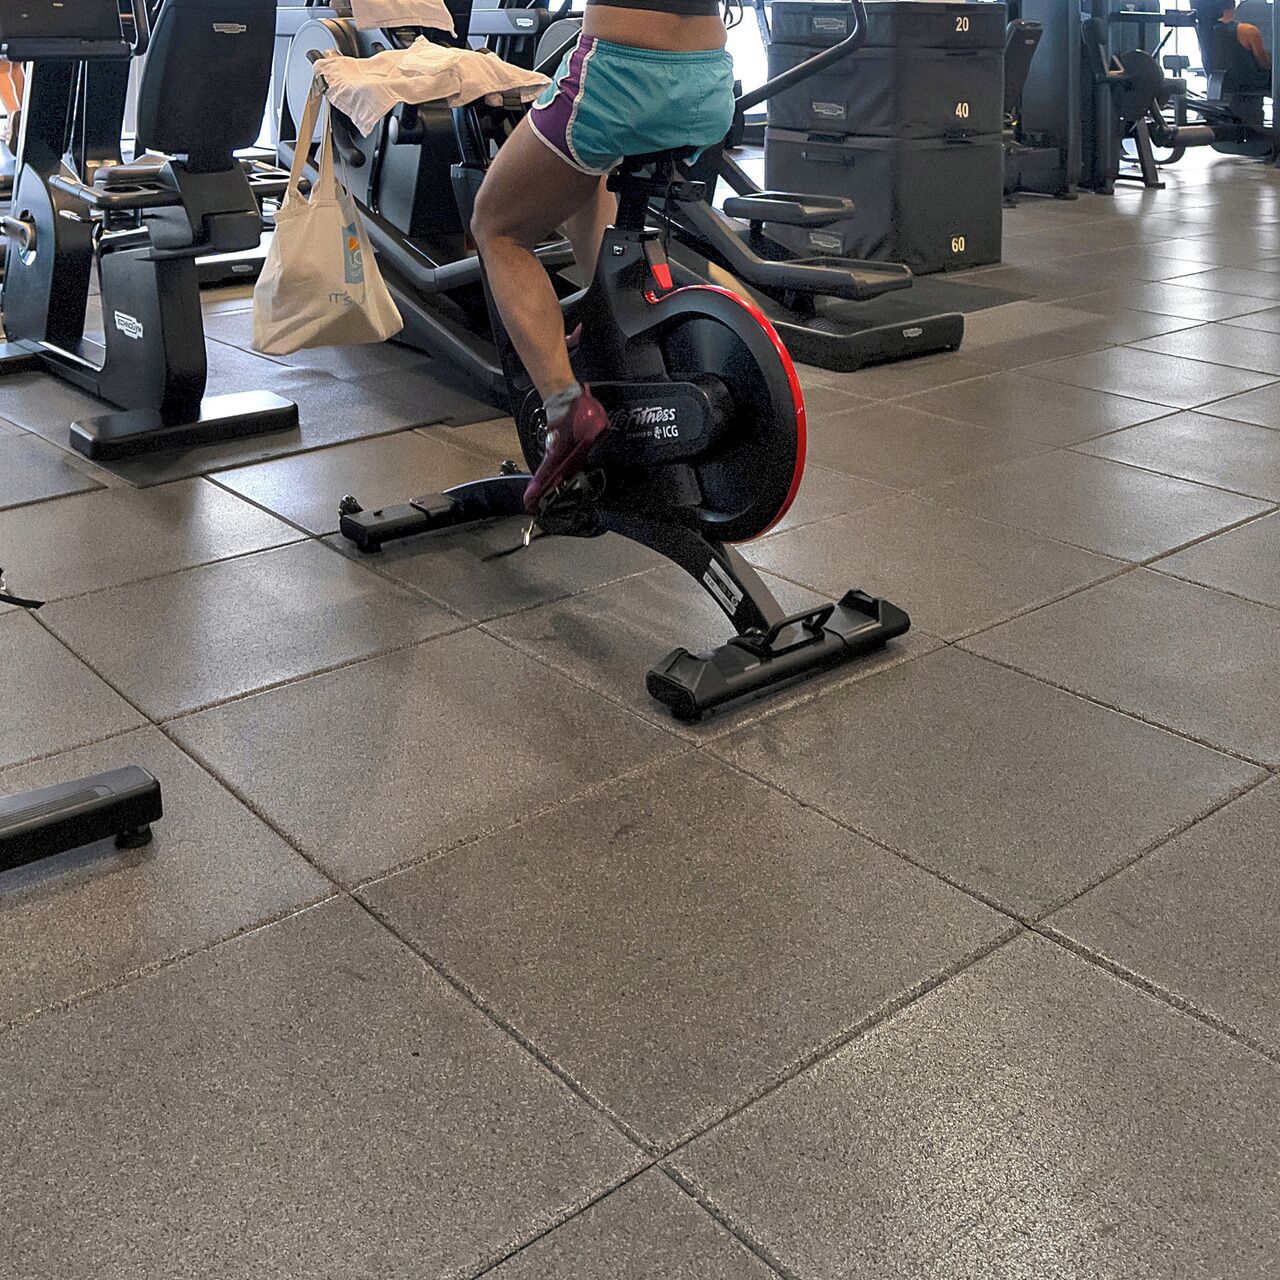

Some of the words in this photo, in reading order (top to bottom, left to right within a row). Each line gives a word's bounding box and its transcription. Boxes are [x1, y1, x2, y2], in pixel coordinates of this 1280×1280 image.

[955, 16, 970, 32] 20
[955, 102, 969, 118] 40
[951, 236, 965, 252] 60
[628, 406, 676, 425] Fitness
[662, 424, 679, 438] ICG
